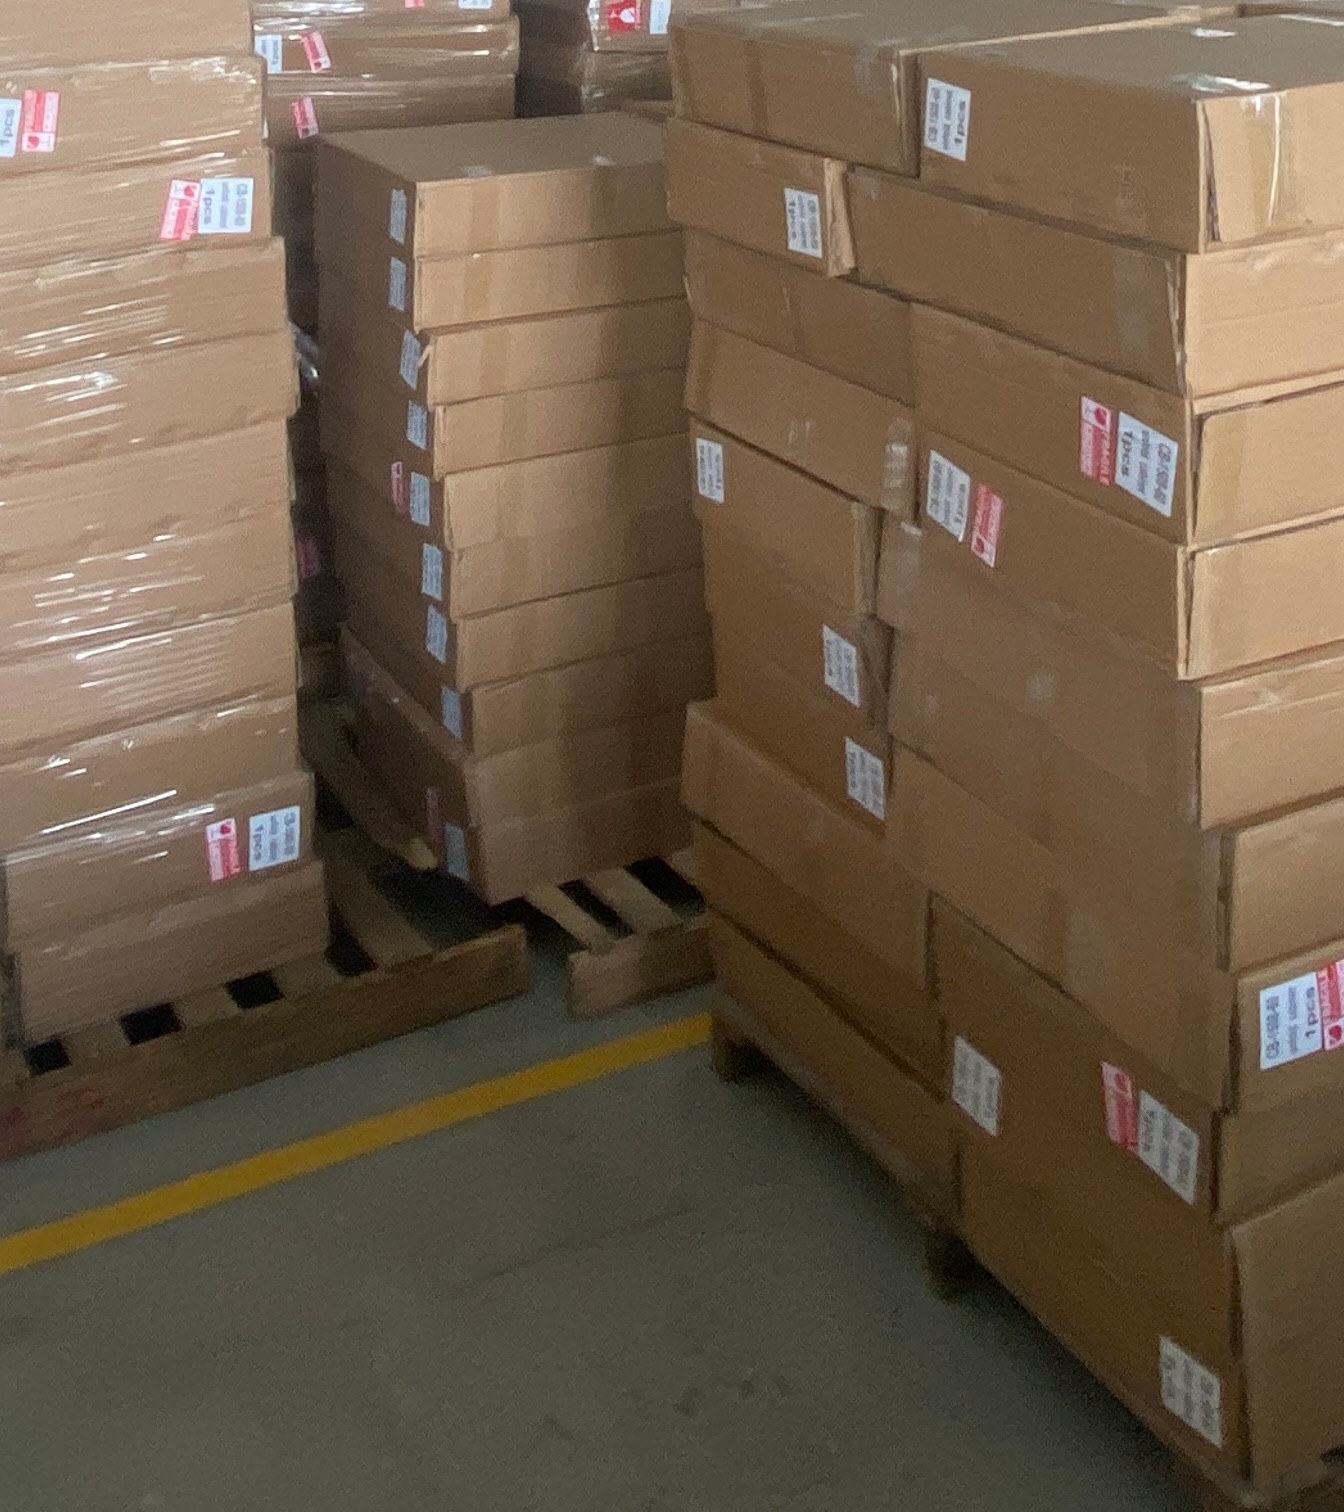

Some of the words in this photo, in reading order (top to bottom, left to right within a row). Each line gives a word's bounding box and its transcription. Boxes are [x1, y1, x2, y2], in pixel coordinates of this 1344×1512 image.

[0, 109, 15, 146] 1pcs
[954, 101, 966, 146] 1pcs
[203, 187, 215, 225] 1pcs
[1098, 431, 1111, 486] FRAGILE
[1121, 430, 1134, 478] 1pcs
[1304, 987, 1319, 1039] 1pcs
